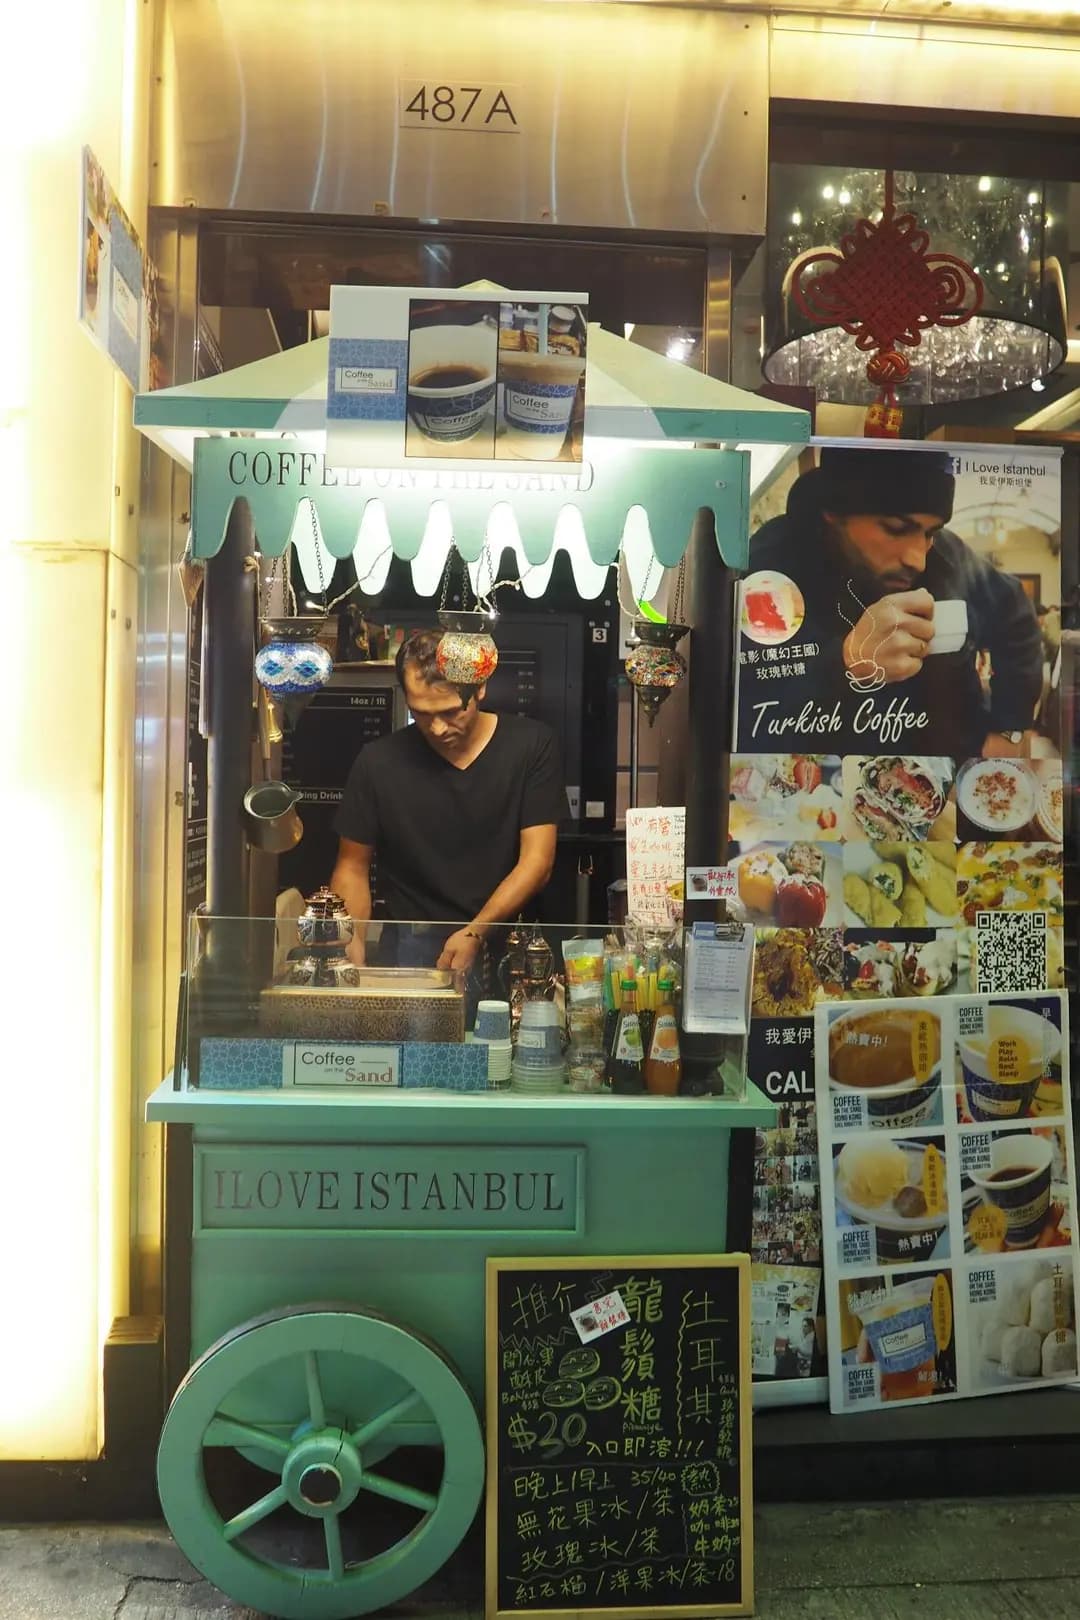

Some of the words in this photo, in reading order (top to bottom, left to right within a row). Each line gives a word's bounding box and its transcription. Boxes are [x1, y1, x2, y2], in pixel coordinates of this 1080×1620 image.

[405, 85, 518, 125] 487A
[345, 370, 374, 379] Coffee
[512, 394, 549, 409] Coffee
[973, 462, 999, 473] Love
[1003, 464, 1046, 476] Istanbul
[751, 700, 842, 737] Turkish
[853, 697, 929, 743] Coffee
[959, 1007, 984, 1017] COFFEE
[765, 1028, 812, 1045] 我愛伊
[301, 1051, 355, 1066] Coffee
[345, 1066, 393, 1083] Sand
[766, 1070, 814, 1095] CAL
[833, 1095, 861, 1107] COFFEE
[961, 1134, 989, 1147] COFFEE
[354, 1171, 564, 1211] ISTANBUL
[842, 1230, 870, 1242] COFFEE
[969, 1270, 995, 1282] COFFEE
[512, 1281, 576, 1328] 推介
[848, 1368, 873, 1380] COFFEE
[508, 1412, 587, 1457] $20
[631, 1467, 676, 1488] 35/40
